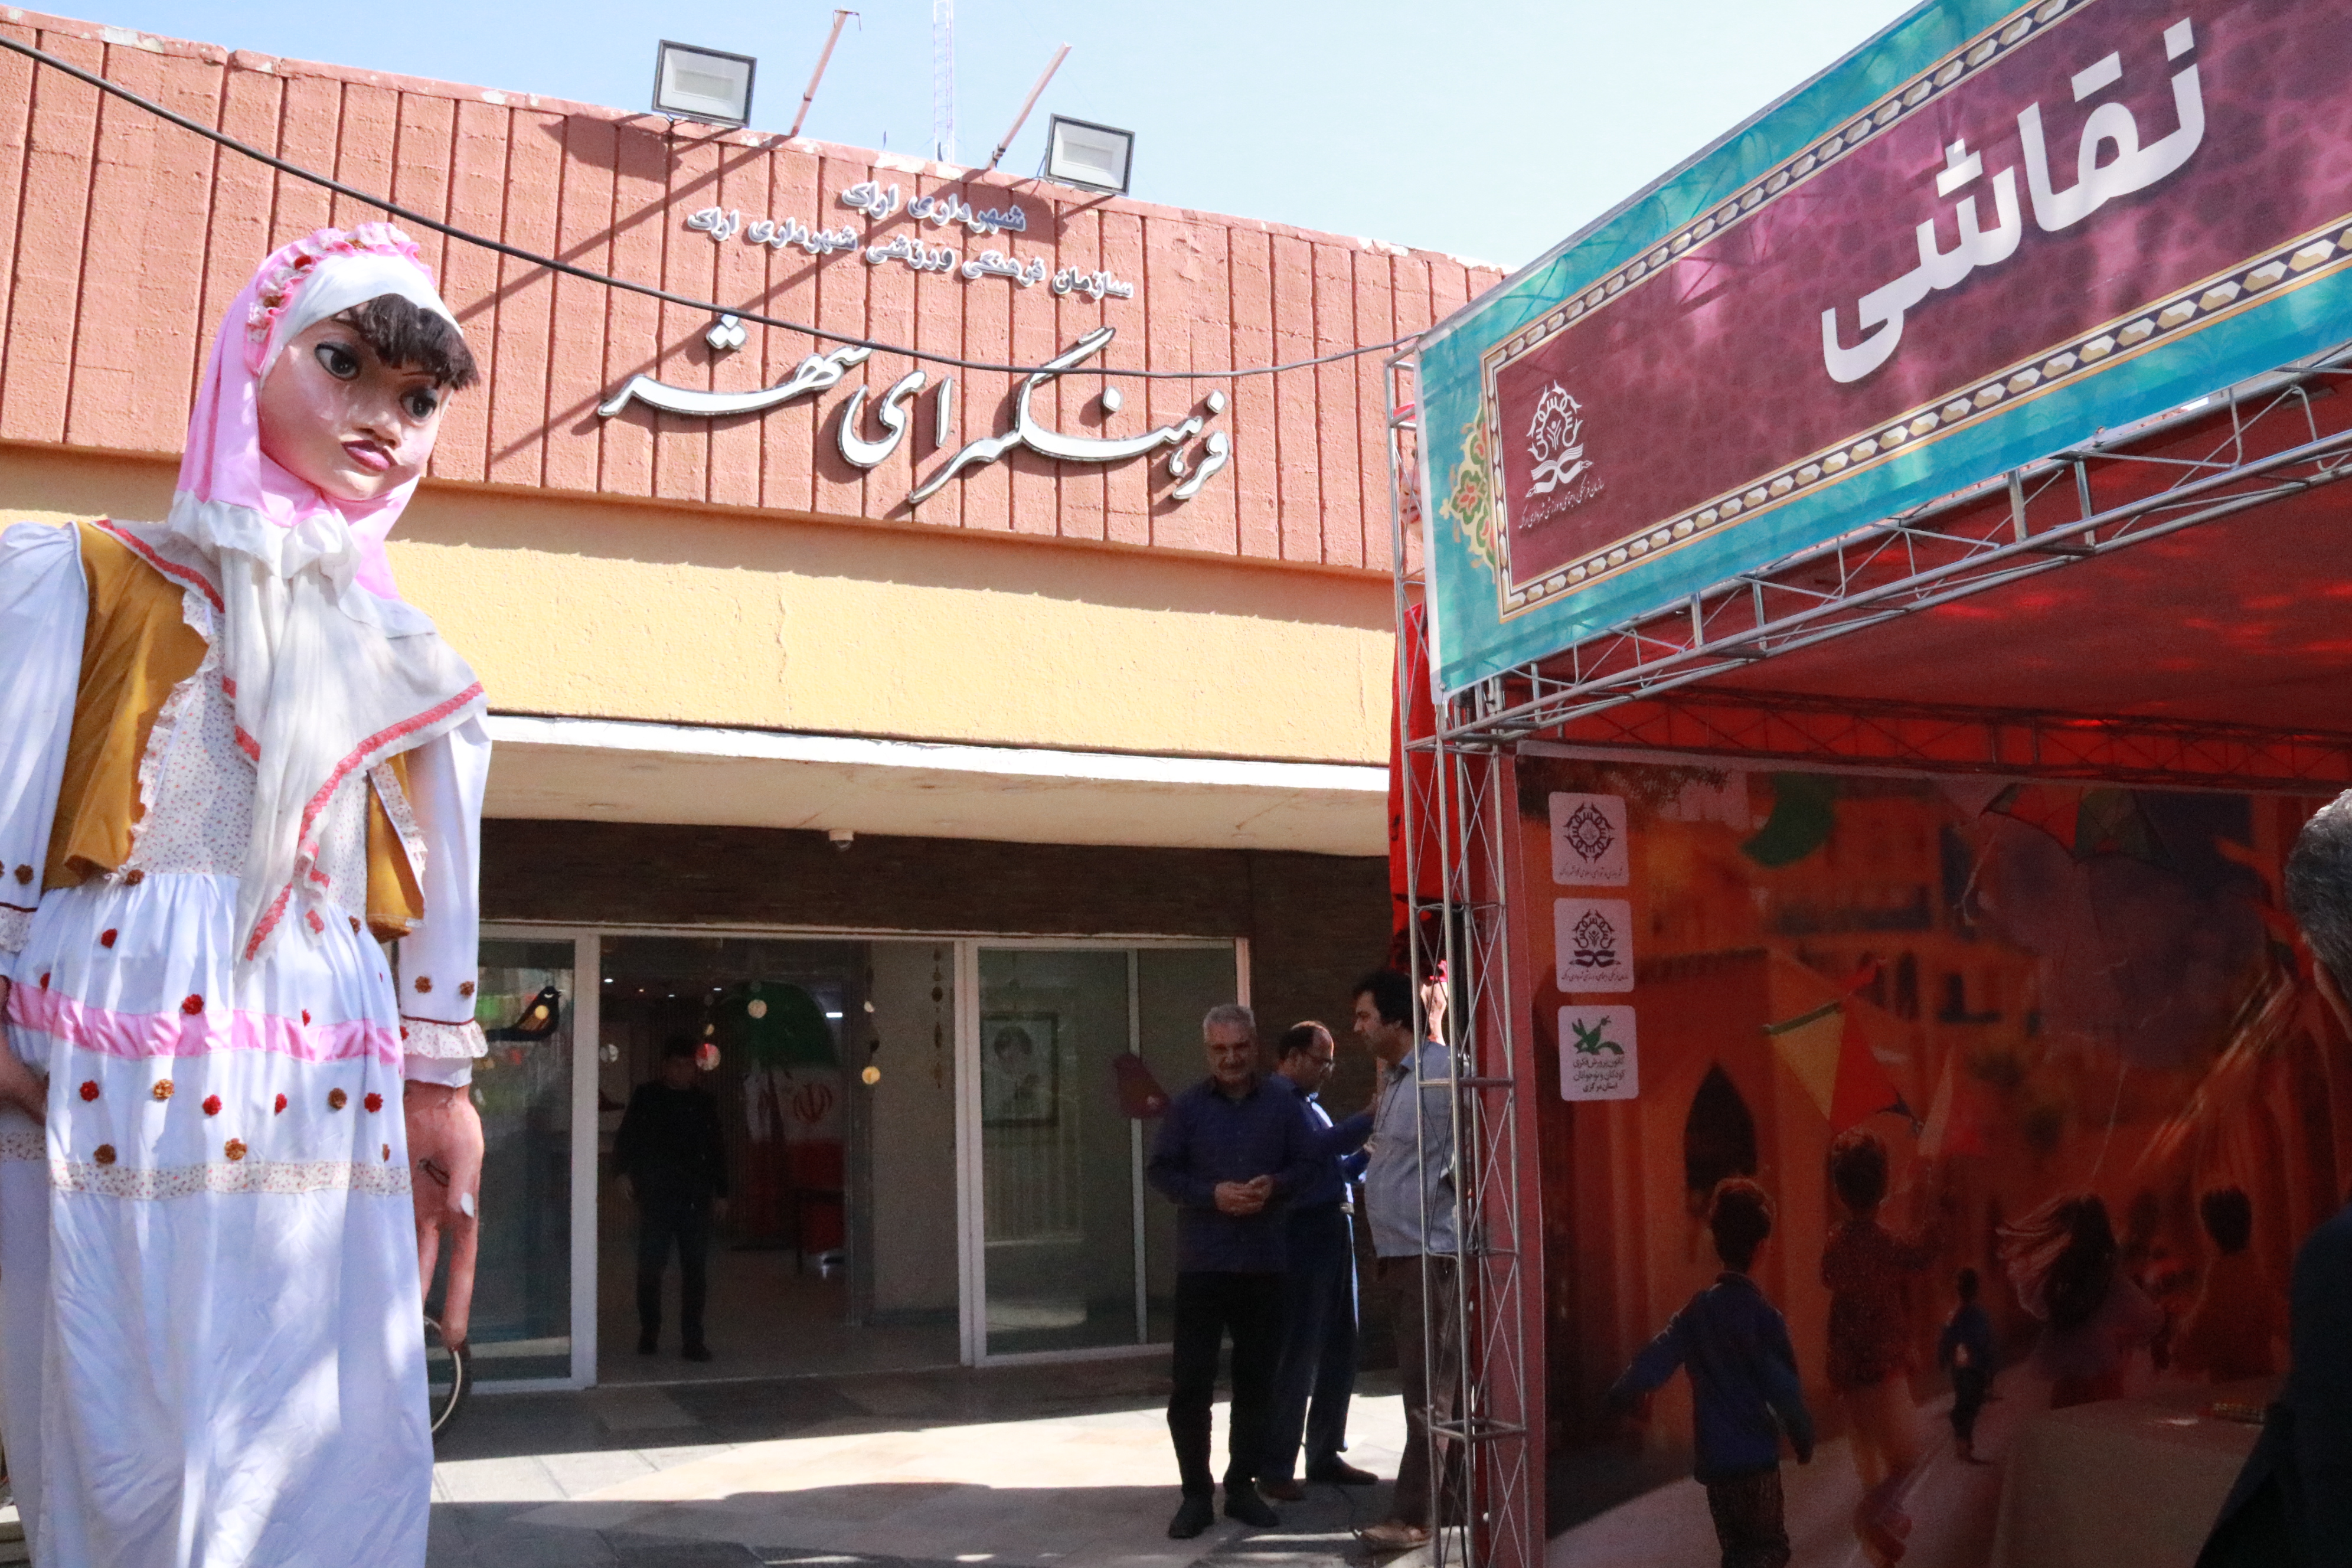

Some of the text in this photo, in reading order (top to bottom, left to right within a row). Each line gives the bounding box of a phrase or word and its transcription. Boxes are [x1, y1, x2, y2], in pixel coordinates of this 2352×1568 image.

[842, 180, 1026, 234] شهرداری اراک
[1821, 17, 2205, 383] نقاشی
[687, 207, 1133, 299] سازمان فرهنگی ورزشی شهرداری اراک
